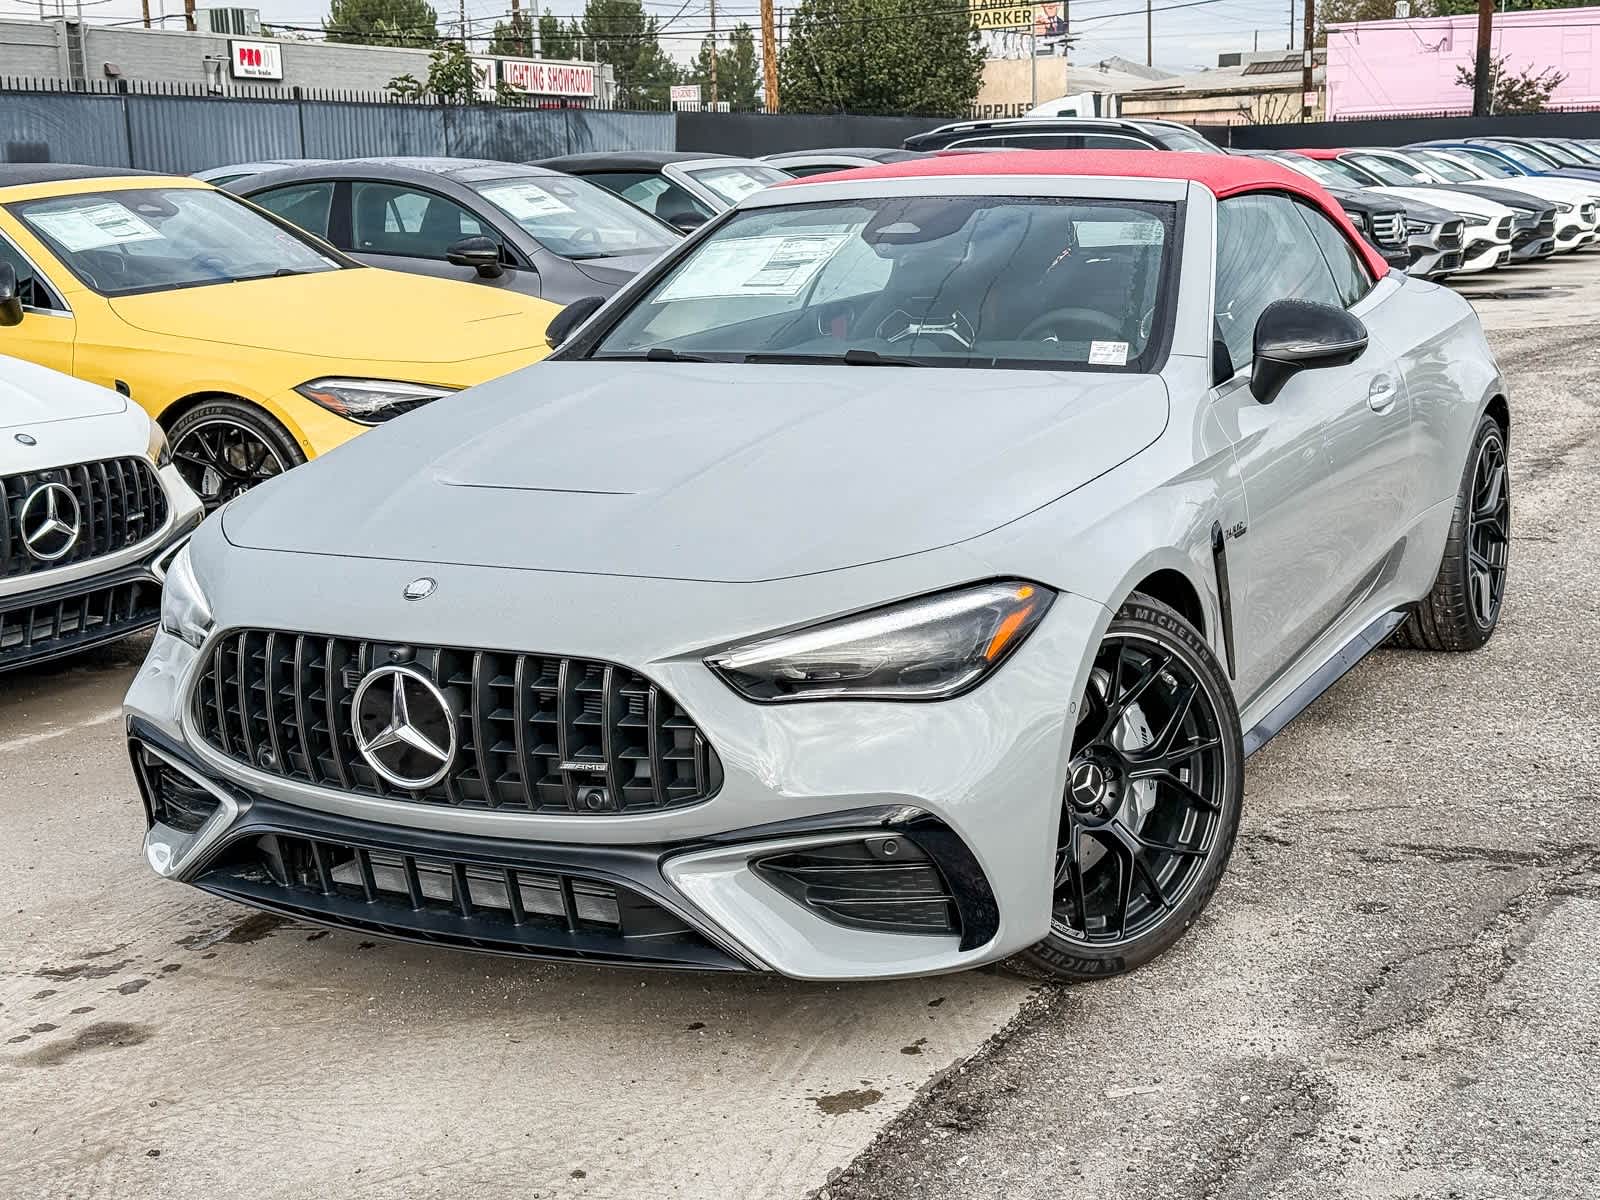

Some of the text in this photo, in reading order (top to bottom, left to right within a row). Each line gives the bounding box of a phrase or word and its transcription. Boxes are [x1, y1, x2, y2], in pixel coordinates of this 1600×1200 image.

[973, 10, 1032, 26] PARKER
[239, 48, 262, 67] PRO
[504, 63, 545, 92] LIGHTING
[547, 66, 592, 95] SHOWROOM
[1135, 607, 1211, 662] MICHELIN
